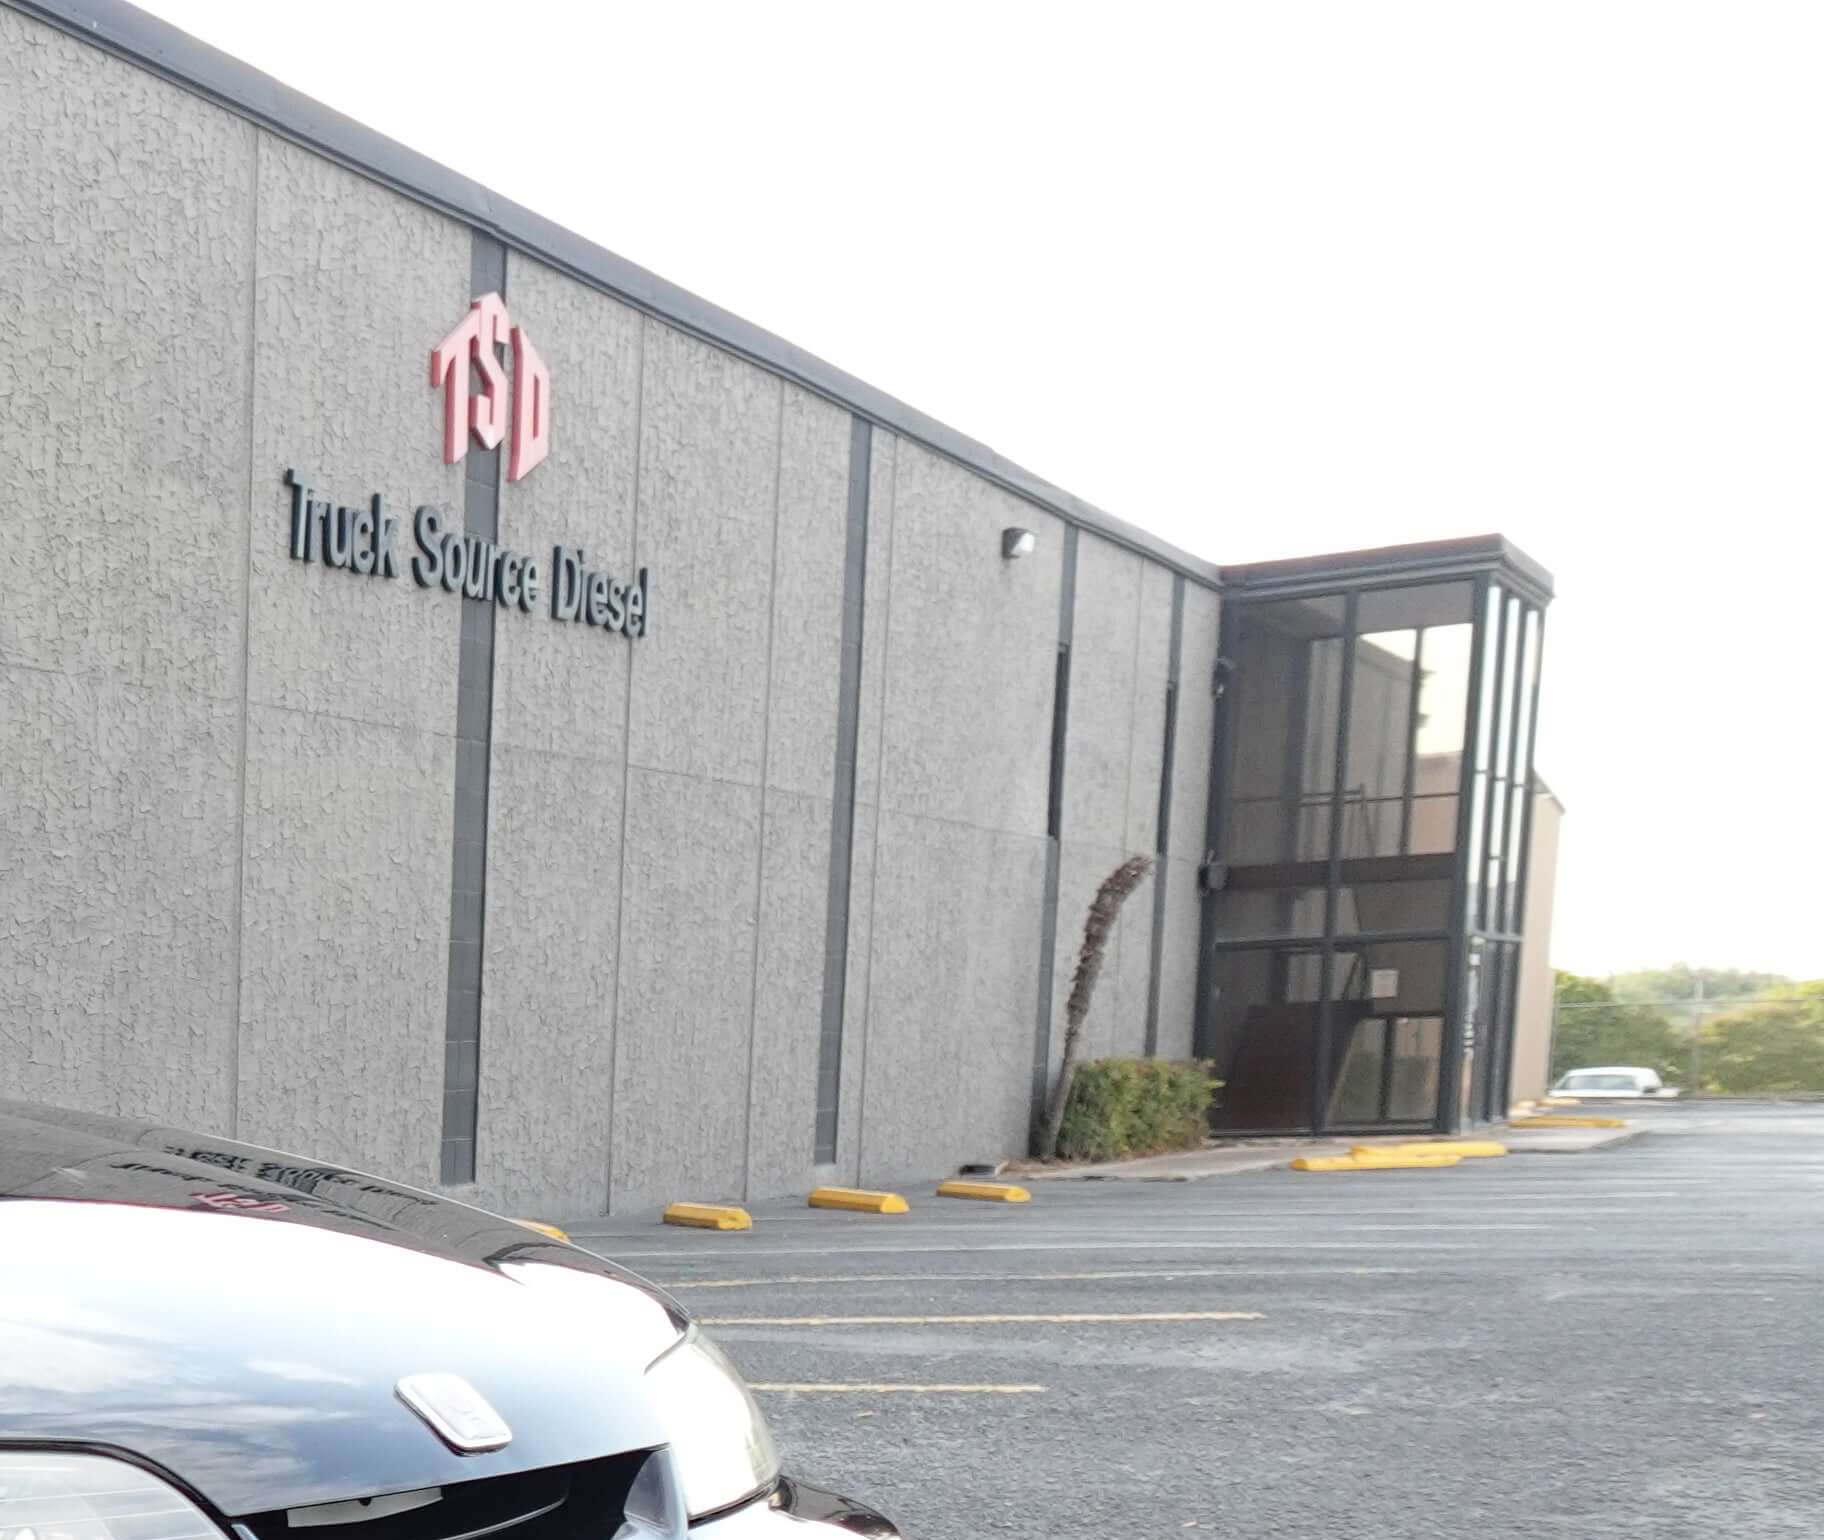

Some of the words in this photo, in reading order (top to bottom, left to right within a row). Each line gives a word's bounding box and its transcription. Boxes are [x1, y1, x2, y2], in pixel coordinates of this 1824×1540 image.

[430, 291, 550, 481] TSD
[283, 468, 400, 578] Truck
[411, 504, 540, 614] Source
[552, 544, 654, 638] Diesel
